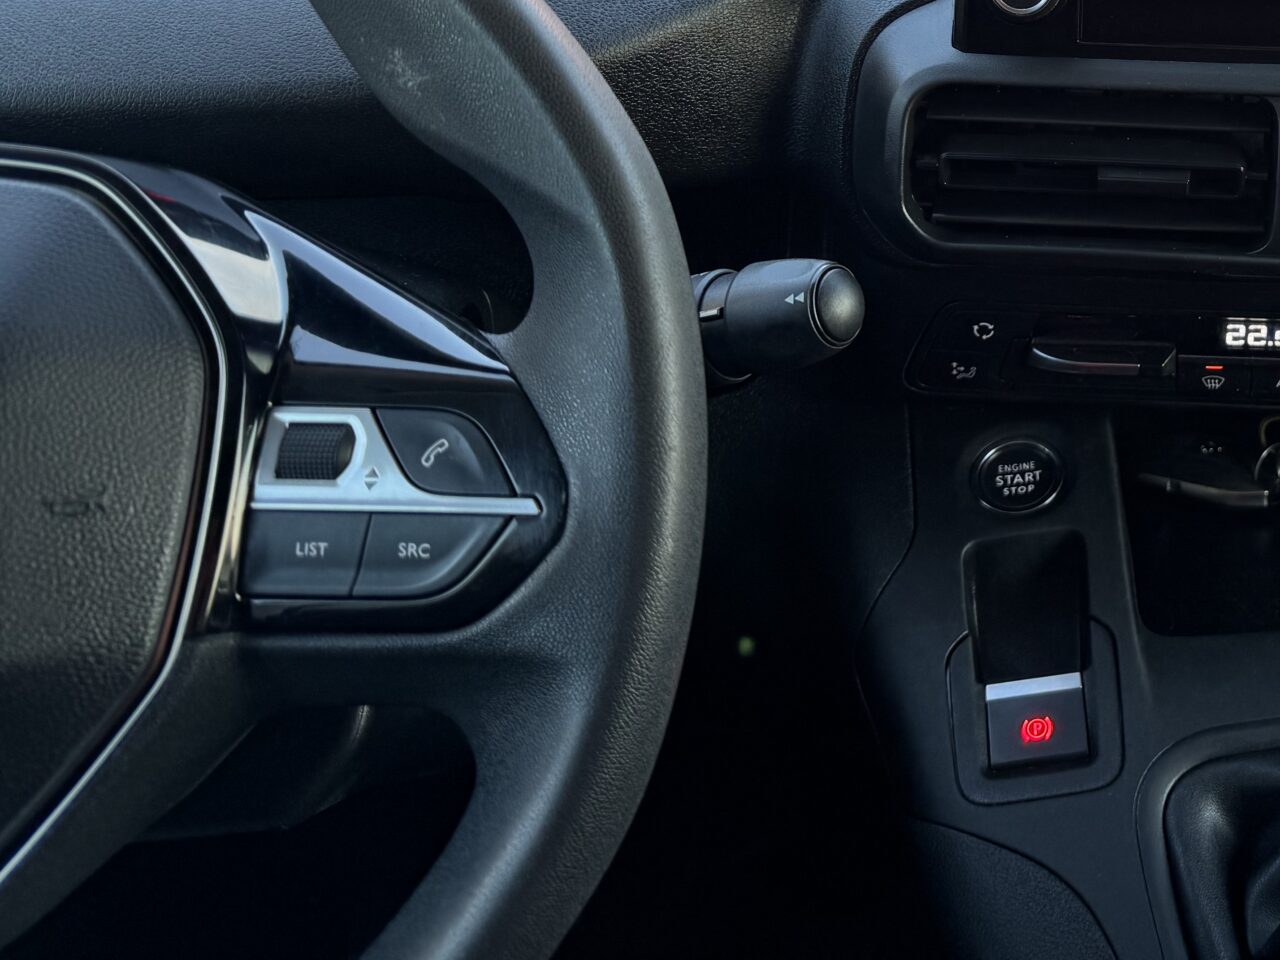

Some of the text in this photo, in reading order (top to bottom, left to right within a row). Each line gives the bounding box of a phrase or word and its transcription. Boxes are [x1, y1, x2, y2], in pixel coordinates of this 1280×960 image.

[998, 461, 1036, 473] ENGINE
[995, 470, 1042, 487] START
[1002, 484, 1035, 496] STOP
[295, 542, 328, 557] LIST
[398, 543, 430, 559] SRC
